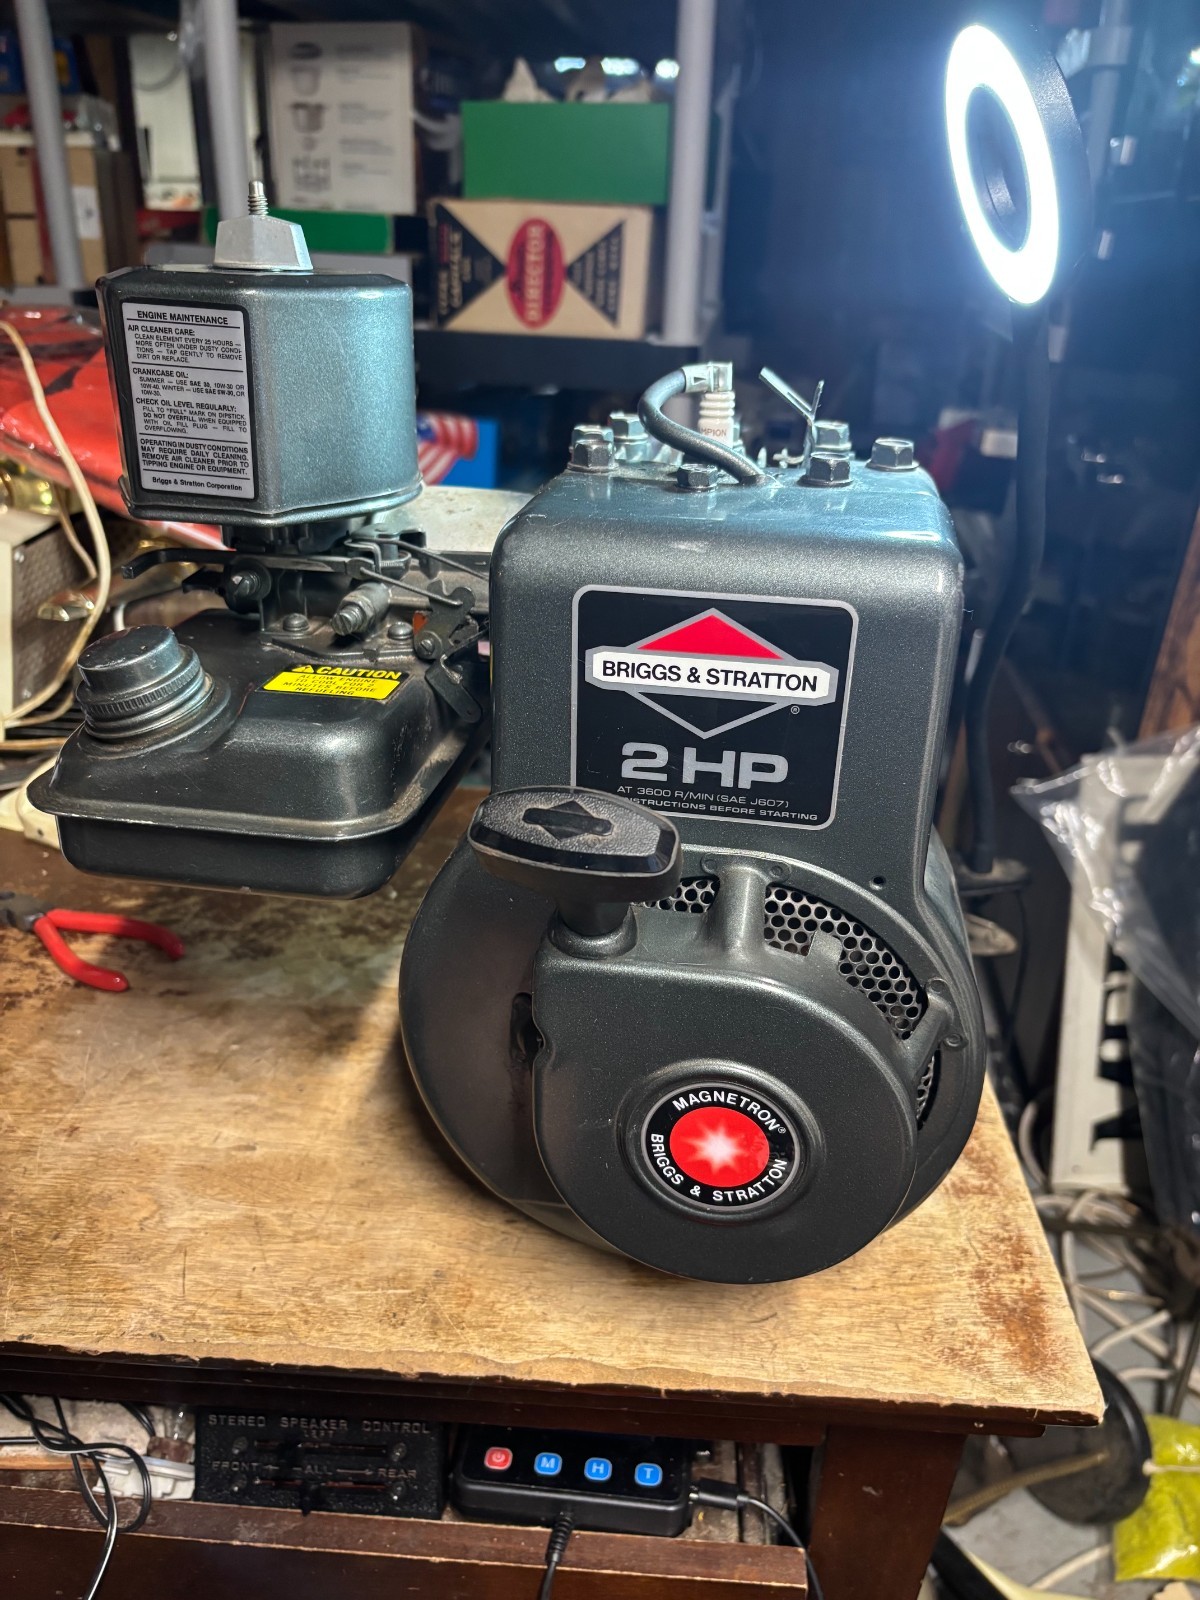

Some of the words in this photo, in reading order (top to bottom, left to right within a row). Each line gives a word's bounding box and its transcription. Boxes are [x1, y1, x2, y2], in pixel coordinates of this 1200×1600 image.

[136, 310, 167, 320] ENGINE
[170, 312, 228, 325] MAINTENANCE
[128, 324, 139, 332] AIR
[141, 325, 173, 335] CLEANER
[175, 327, 195, 336] CARE:
[156, 335, 183, 343] ELEMENT
[136, 346, 154, 354] TIONS
[180, 350, 203, 358] GENTLY
[217, 353, 243, 361] REMOVE
[155, 341, 175, 349] OFTEN
[199, 344, 219, 352] DUSTY
[132, 367, 175, 378] CRANKCASE
[175, 371, 189, 379] OIL:
[162, 384, 185, 392] WINTER
[135, 397, 159, 405] CHECK
[161, 399, 172, 407] OIL
[173, 400, 195, 409] LEVEL
[192, 422, 208, 430] PLUG
[198, 416, 216, 424] WHEN
[218, 418, 247, 427] EQUIPPED
[700, 427, 728, 437] MPION
[140, 438, 177, 448] OPERATING
[185, 442, 206, 450] DUSTY
[206, 444, 248, 454] CONDITIONS
[158, 447, 188, 456] REQUIRE
[191, 450, 210, 458] DAILY
[141, 452, 170, 461] REMOVE
[185, 456, 216, 465] CLEANER
[217, 459, 238, 467] PRIOR
[142, 459, 168, 468] TIPPING
[170, 462, 195, 471] ENGINE
[152, 476, 172, 485] Briggs
[180, 479, 205, 488] Stratton
[206, 481, 243, 491] Corporation
[316, 666, 402, 680] CAUTION
[602, 660, 682, 682] BRIGGS
[686, 666, 701, 684] &
[705, 667, 818, 693] STRATTON
[295, 687, 355, 696] REFUELING
[335, 685, 377, 693] BEFORE
[621, 742, 669, 782] 2
[682, 746, 789, 790] HP
[617, 785, 633, 794] AT
[637, 787, 672, 797] 3600
[674, 790, 715, 802] R/MIN
[716, 793, 747, 805] (SAE
[750, 798, 789, 809] J607)
[709, 804, 756, 815] BEFORE
[759, 809, 818, 821] STARTING
[650, 1133, 685, 1186] BRIGGS
[689, 1185, 701, 1198] &
[712, 1158, 788, 1203] STRATTON
[208, 1414, 267, 1428] STEREO
[280, 1416, 348, 1430] SPEAKER
[361, 1420, 431, 1434] CONTROL
[211, 1461, 260, 1472] FRONT
[304, 1464, 333, 1475] ALL
[377, 1468, 417, 1479] REAR
[541, 1456, 556, 1469] M
[591, 1462, 605, 1475] H
[643, 1467, 654, 1479] T
